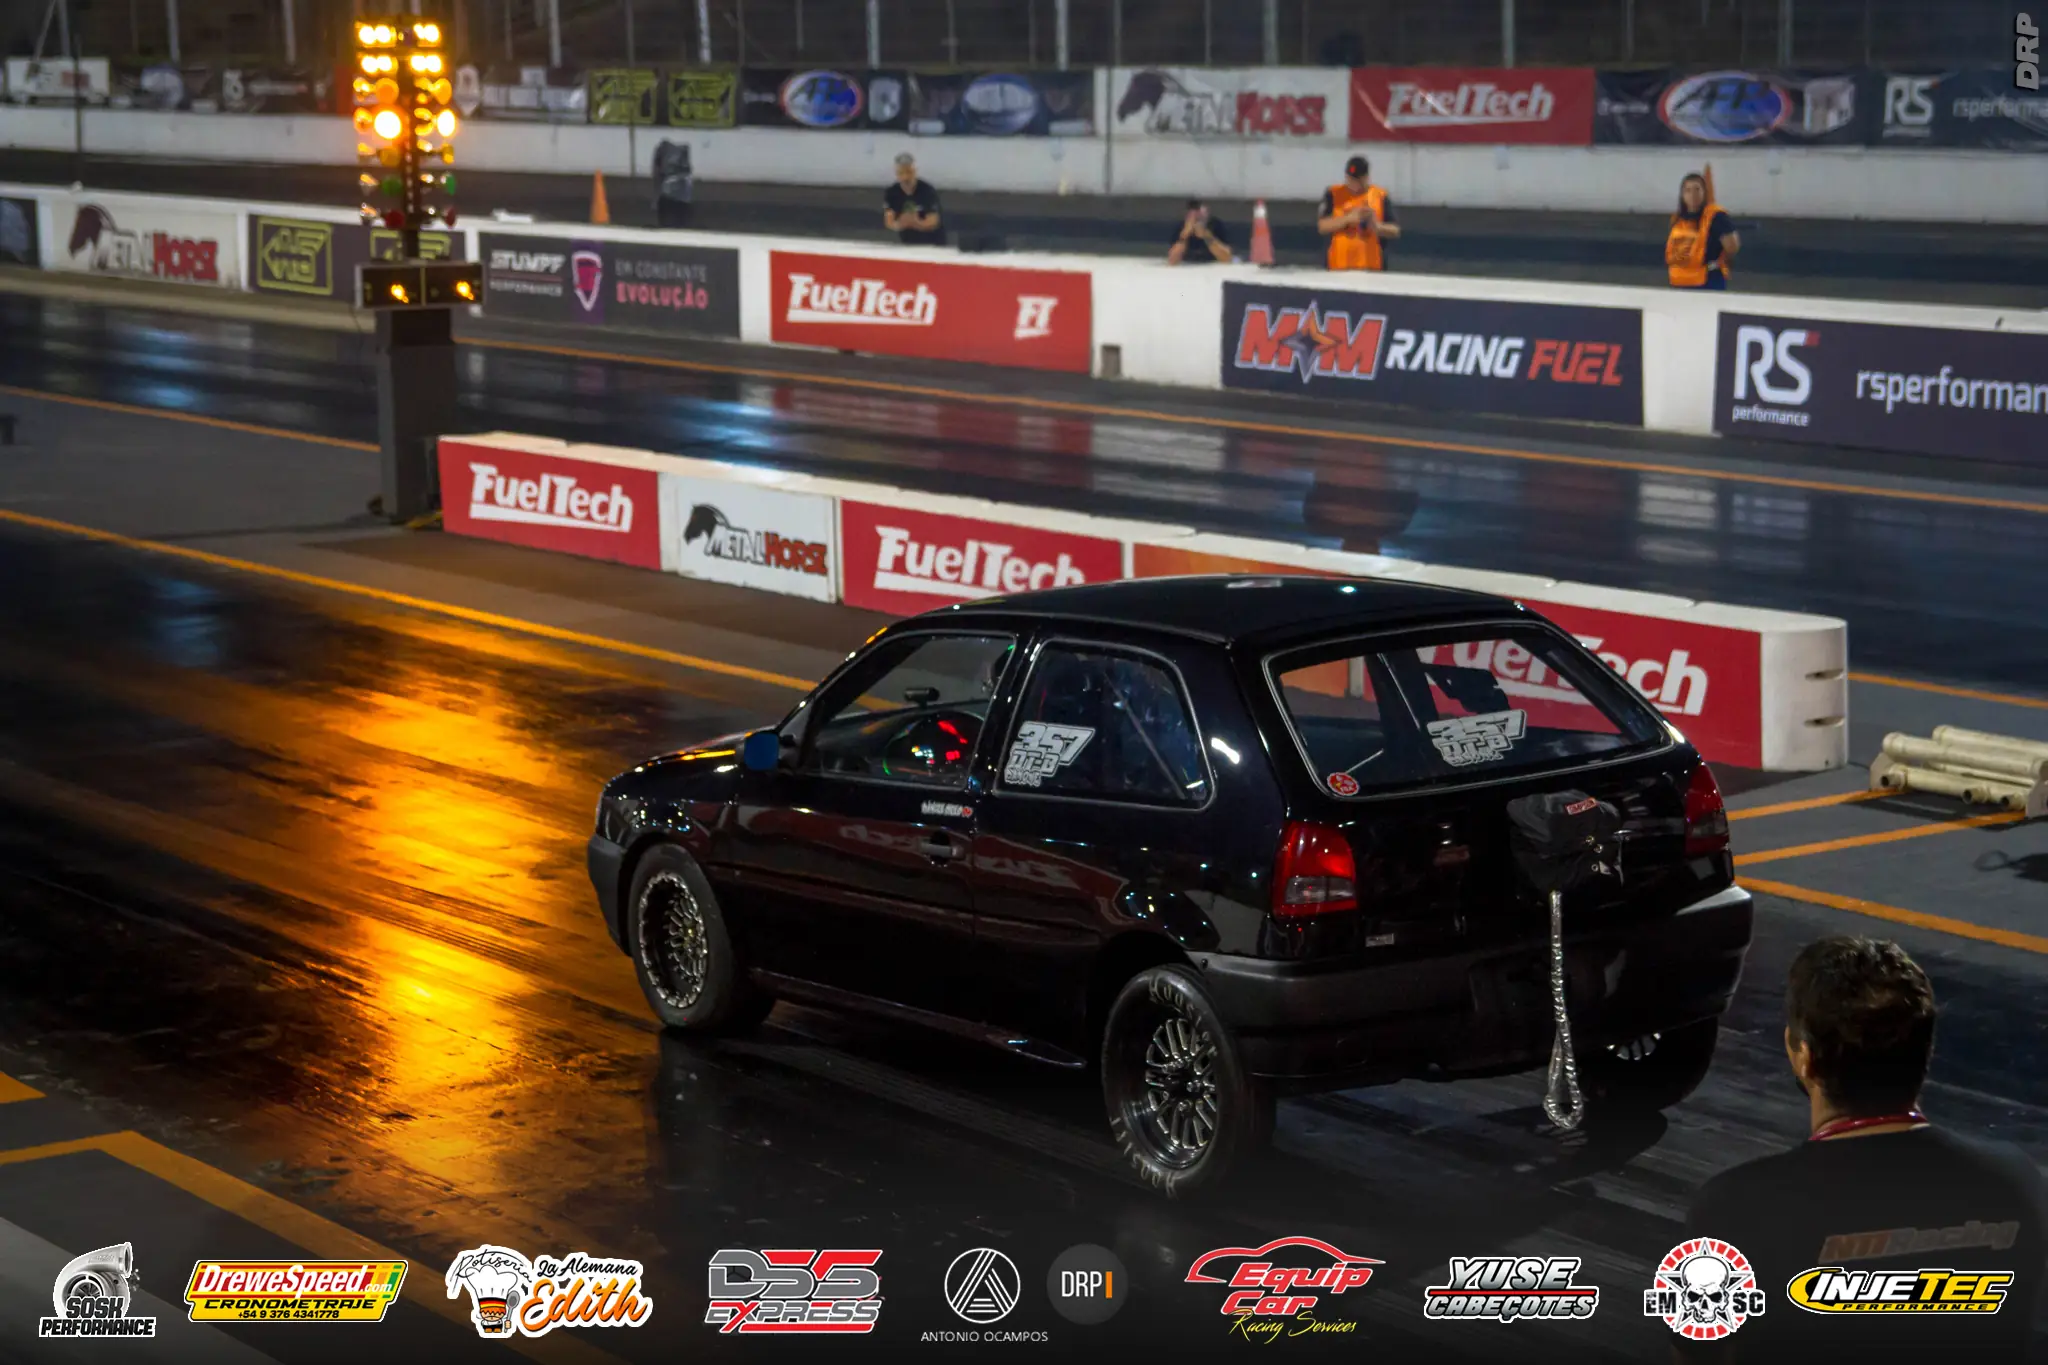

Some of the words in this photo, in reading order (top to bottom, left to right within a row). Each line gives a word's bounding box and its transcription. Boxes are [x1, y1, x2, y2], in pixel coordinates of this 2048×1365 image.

[1385, 82, 1556, 126] FuelTech
[1884, 77, 1934, 125] RS
[636, 262, 708, 282] CONSTANTE
[615, 280, 709, 311] EVOLUÇÃO
[787, 273, 937, 325] FuelTech
[1014, 295, 1058, 339] FT
[1384, 329, 1525, 379] RACING
[1527, 338, 1623, 386] FUEL
[1734, 325, 1812, 405] RS
[1856, 365, 2048, 413] rsperforman
[1732, 402, 1810, 426] performance
[469, 462, 633, 533] FuelTech
[873, 525, 1085, 599] FuelTech
[1017, 721, 1096, 766] 357
[1427, 708, 1527, 742] 357
